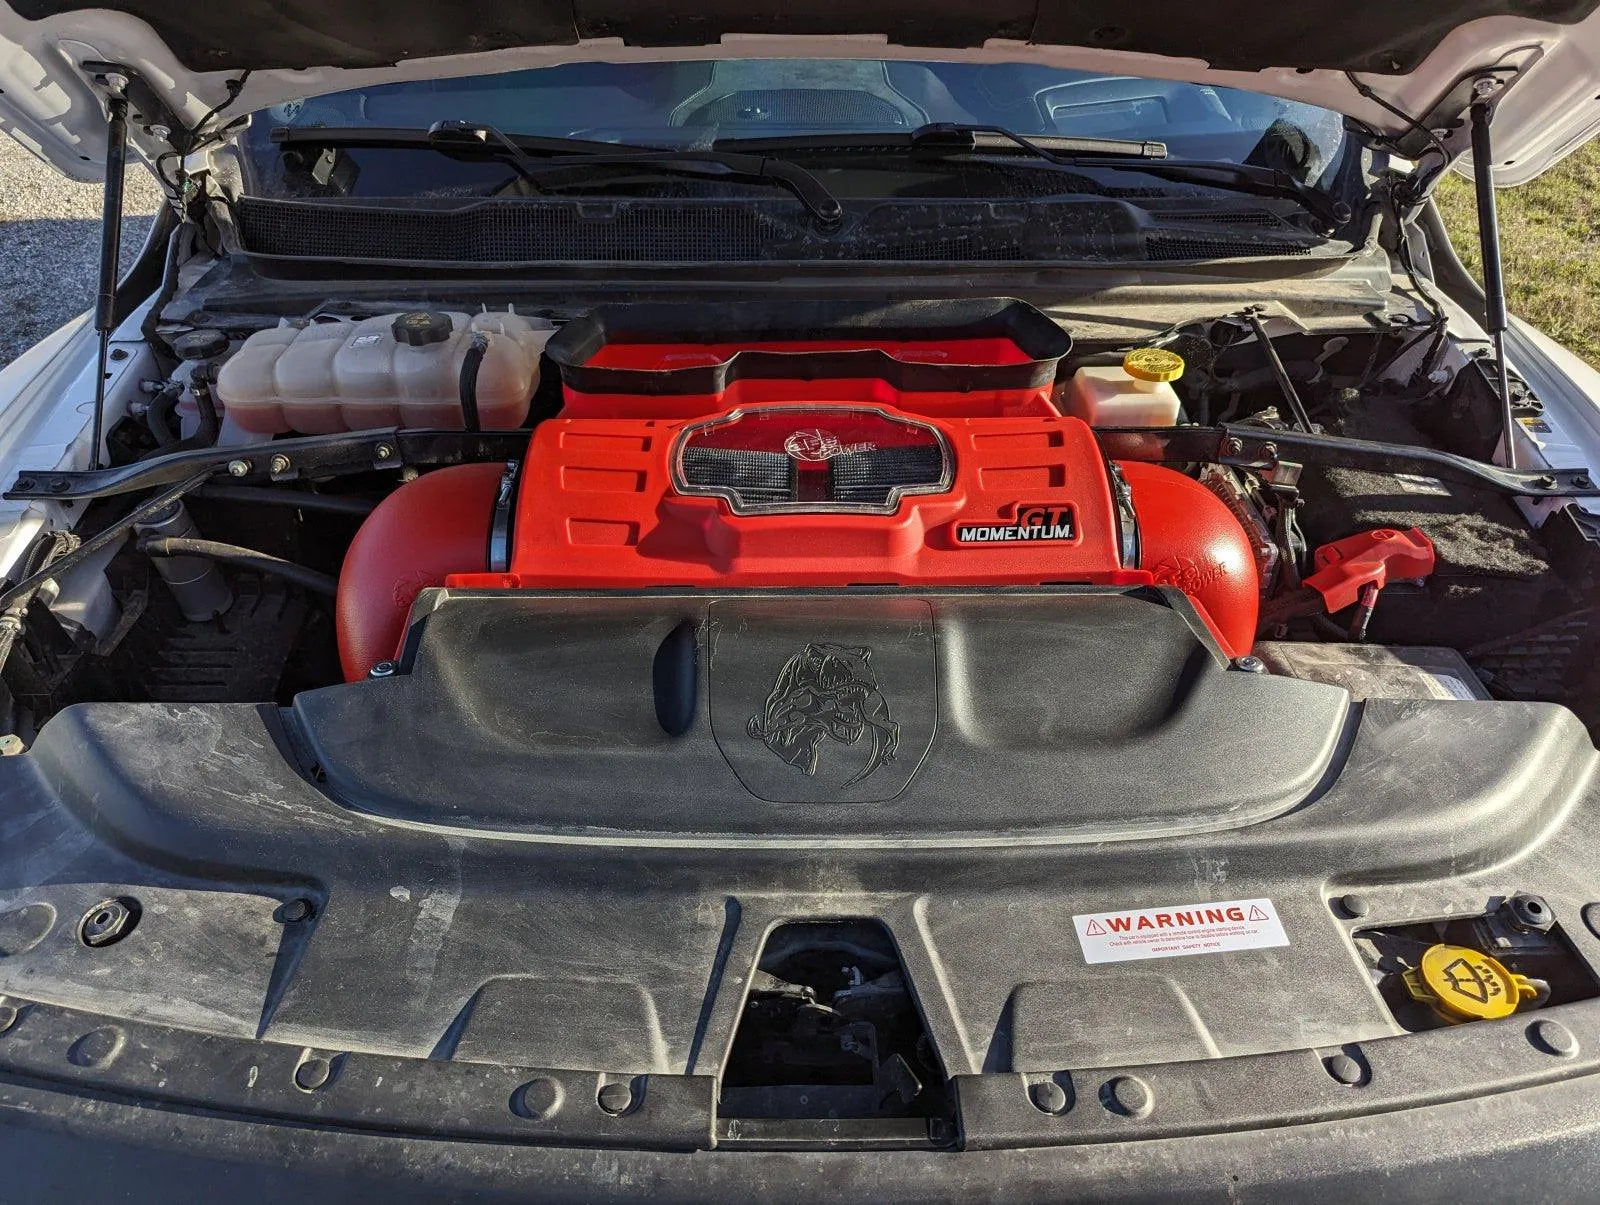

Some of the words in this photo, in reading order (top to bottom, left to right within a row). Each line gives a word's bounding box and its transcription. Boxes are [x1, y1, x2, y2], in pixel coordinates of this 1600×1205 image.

[1020, 507, 1068, 527] GT
[961, 525, 1070, 541] MOMENTUM
[1105, 907, 1245, 932] WARNING
